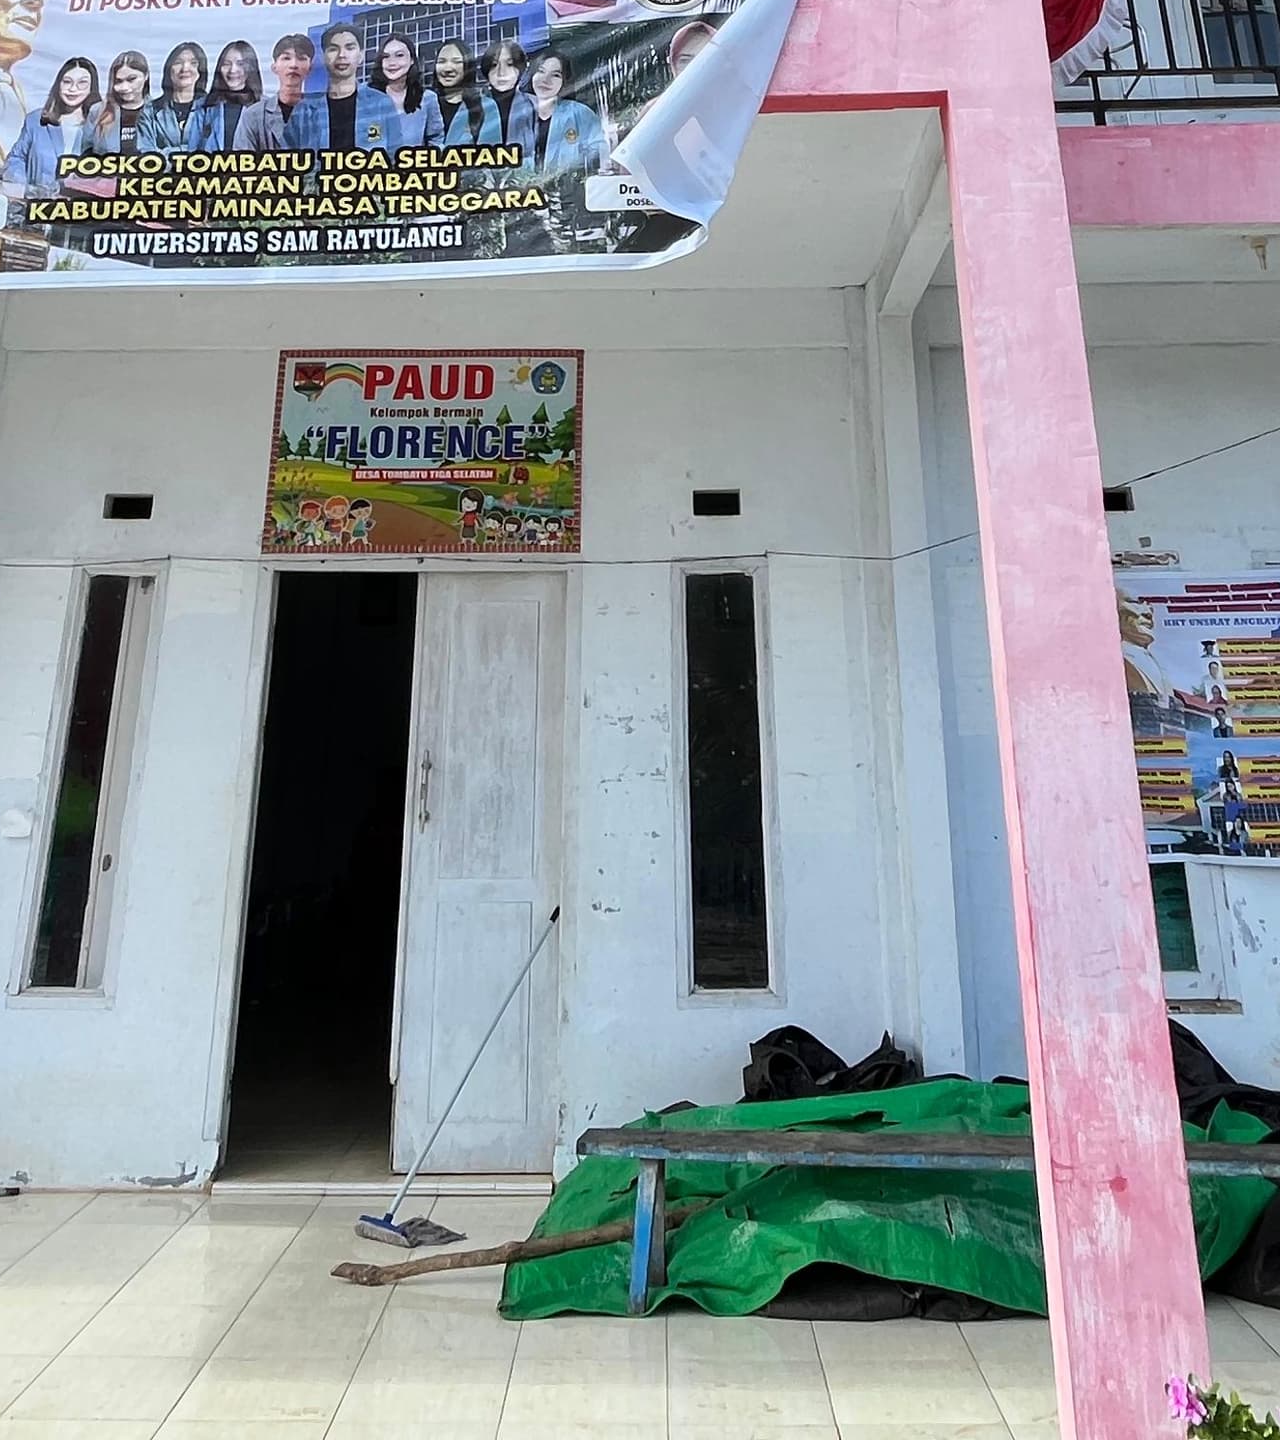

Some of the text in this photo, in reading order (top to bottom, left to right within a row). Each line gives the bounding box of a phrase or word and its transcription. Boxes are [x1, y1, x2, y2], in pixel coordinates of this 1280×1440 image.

[59, 147, 519, 176] POSKO TOMBATU TIGA SELATAN
[120, 172, 458, 197] KECAMATAN TOMBATU
[28, 189, 544, 221] KABUPATEN MINAHASA TENGGARA
[93, 225, 463, 255] UNIVERSITAS SAM RATULANGI
[363, 364, 495, 401] PAUD
[370, 407, 485, 419] Kelompok Bermain
[355, 469, 494, 480] DESA TOMBATU TIGA SELATAN
